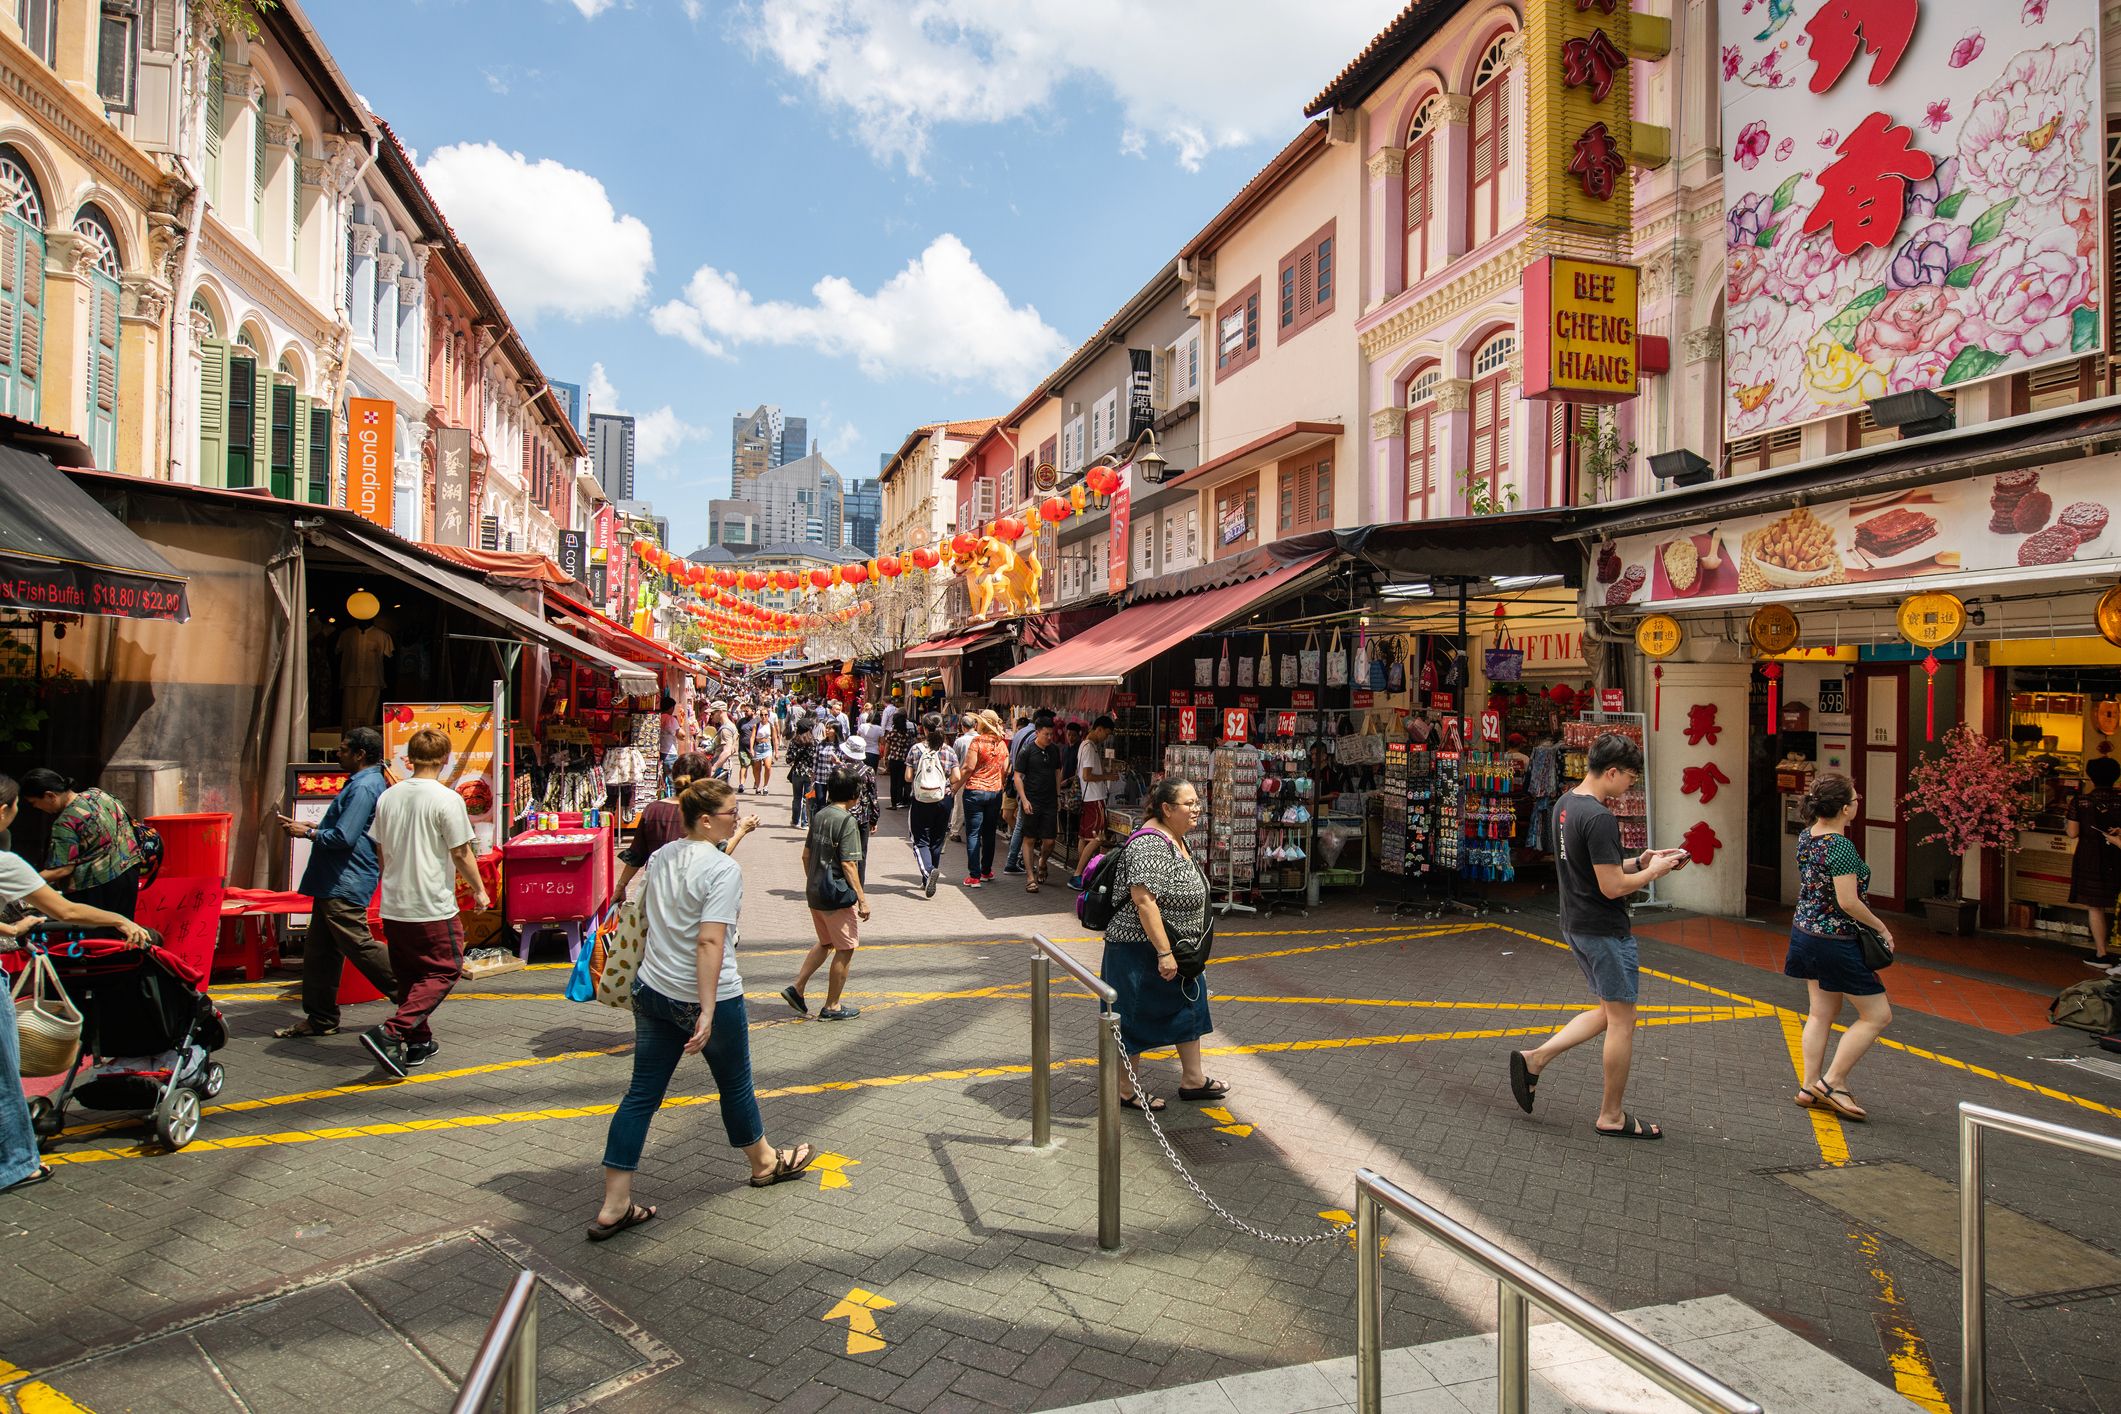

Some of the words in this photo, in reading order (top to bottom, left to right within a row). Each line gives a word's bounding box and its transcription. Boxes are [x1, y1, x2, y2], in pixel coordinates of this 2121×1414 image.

[1574, 271, 1616, 303] BEE
[1556, 310, 1632, 345] CHENG
[1557, 350, 1630, 386] HIANG
[359, 430, 381, 514] guardian
[0, 580, 13, 600] st
[17, 580, 46, 601] Fish
[50, 584, 86, 605] Buffet
[94, 584, 135, 608] $18.80
[142, 590, 180, 612] $22.80
[1199, 694, 1207, 705] For
[1820, 694, 1843, 712] 69B
[1182, 710, 1194, 735] $2
[1226, 711, 1245, 739] $2
[1481, 713, 1498, 740] $2
